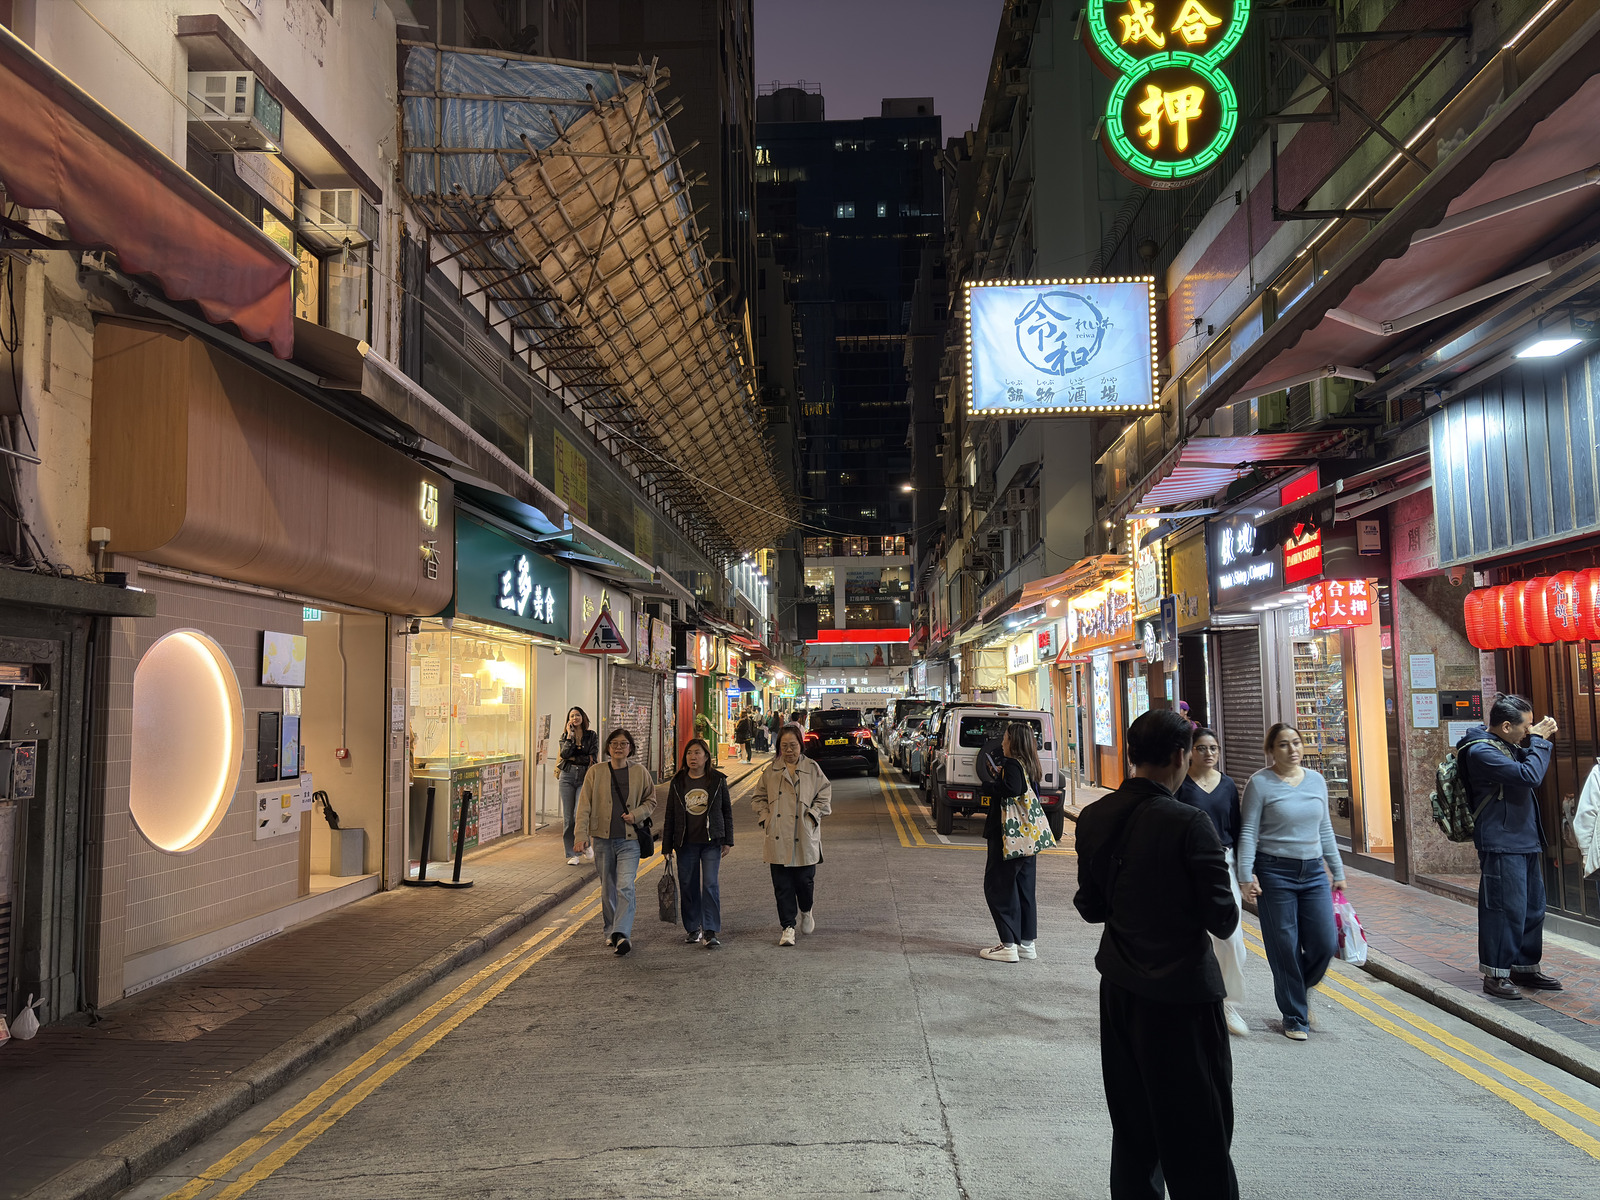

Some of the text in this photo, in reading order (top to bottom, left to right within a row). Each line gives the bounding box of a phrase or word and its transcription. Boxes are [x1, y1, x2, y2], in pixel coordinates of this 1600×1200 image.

[1137, 84, 1205, 152] 押
[1076, 331, 1095, 339] reiwa
[1286, 545, 1321, 568] PAWN SHOP
[1328, 580, 1367, 597] 合成
[1329, 599, 1368, 617] 大押
[1164, 603, 1174, 639] P
